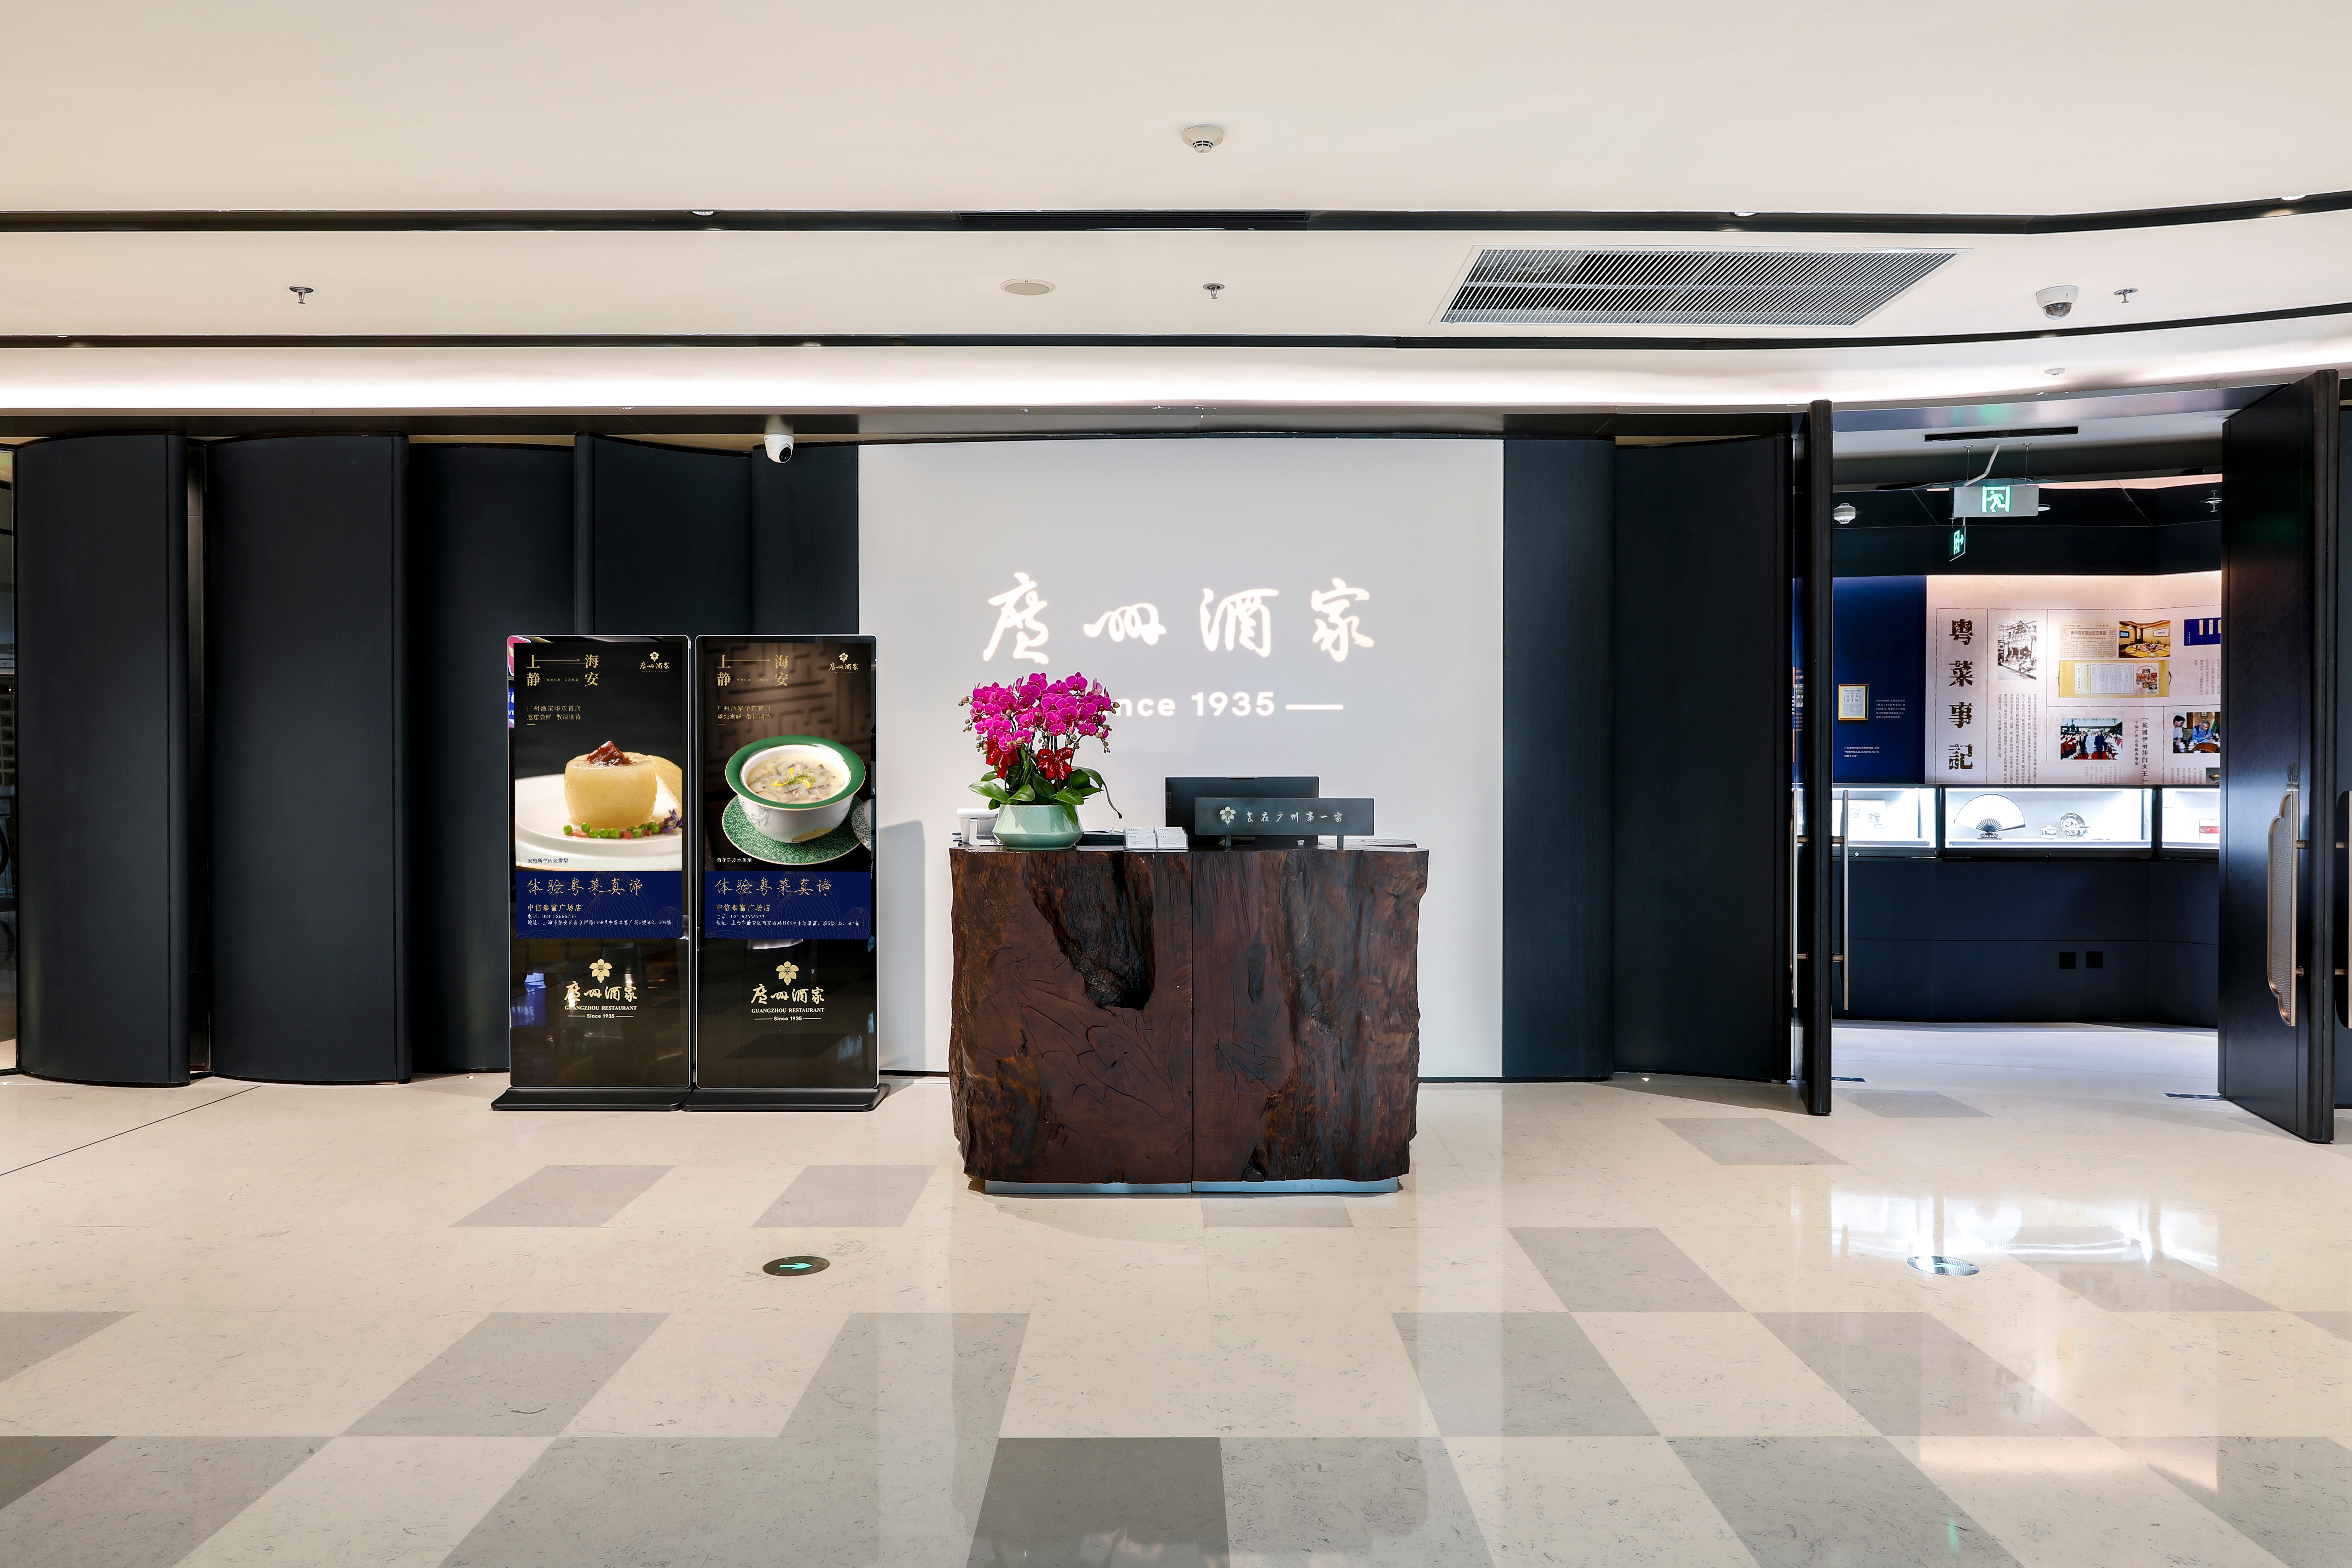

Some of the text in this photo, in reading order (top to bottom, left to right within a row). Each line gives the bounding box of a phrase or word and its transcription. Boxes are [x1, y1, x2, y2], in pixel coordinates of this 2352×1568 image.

[1102, 692, 1275, 717] nce 1935
[1247, 811, 1343, 823] 食在广州第一家
[527, 877, 643, 896] 体验粤菜真谛
[715, 877, 832, 897] 体验粤菜真谛
[527, 903, 582, 912] 中信泰富广场店
[716, 903, 770, 912] 中信泰富广场店
